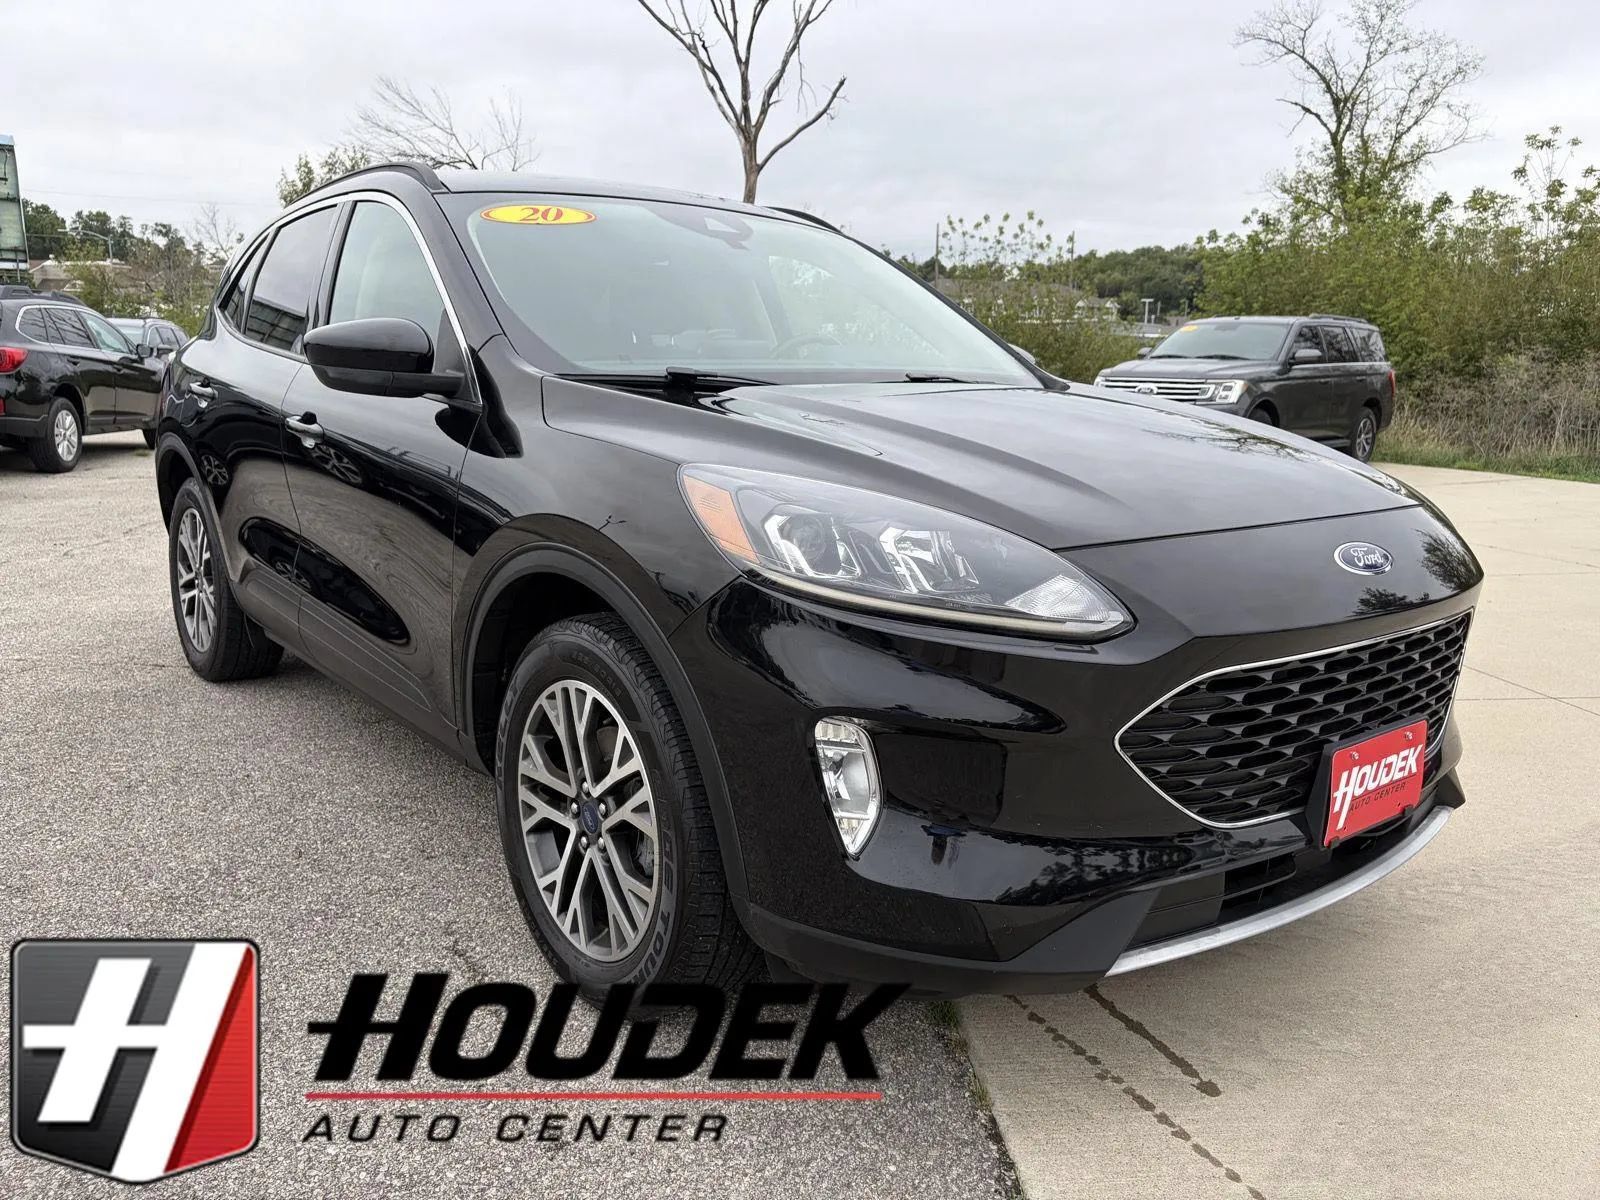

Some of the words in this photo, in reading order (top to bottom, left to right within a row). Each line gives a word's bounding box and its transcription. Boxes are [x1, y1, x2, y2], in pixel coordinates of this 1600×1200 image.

[519, 206, 564, 222] 20
[1350, 547, 1384, 567] Ford
[1333, 743, 1424, 831] HOUDEK
[1349, 795, 1371, 812] AUTO
[1374, 781, 1407, 801] CENTER
